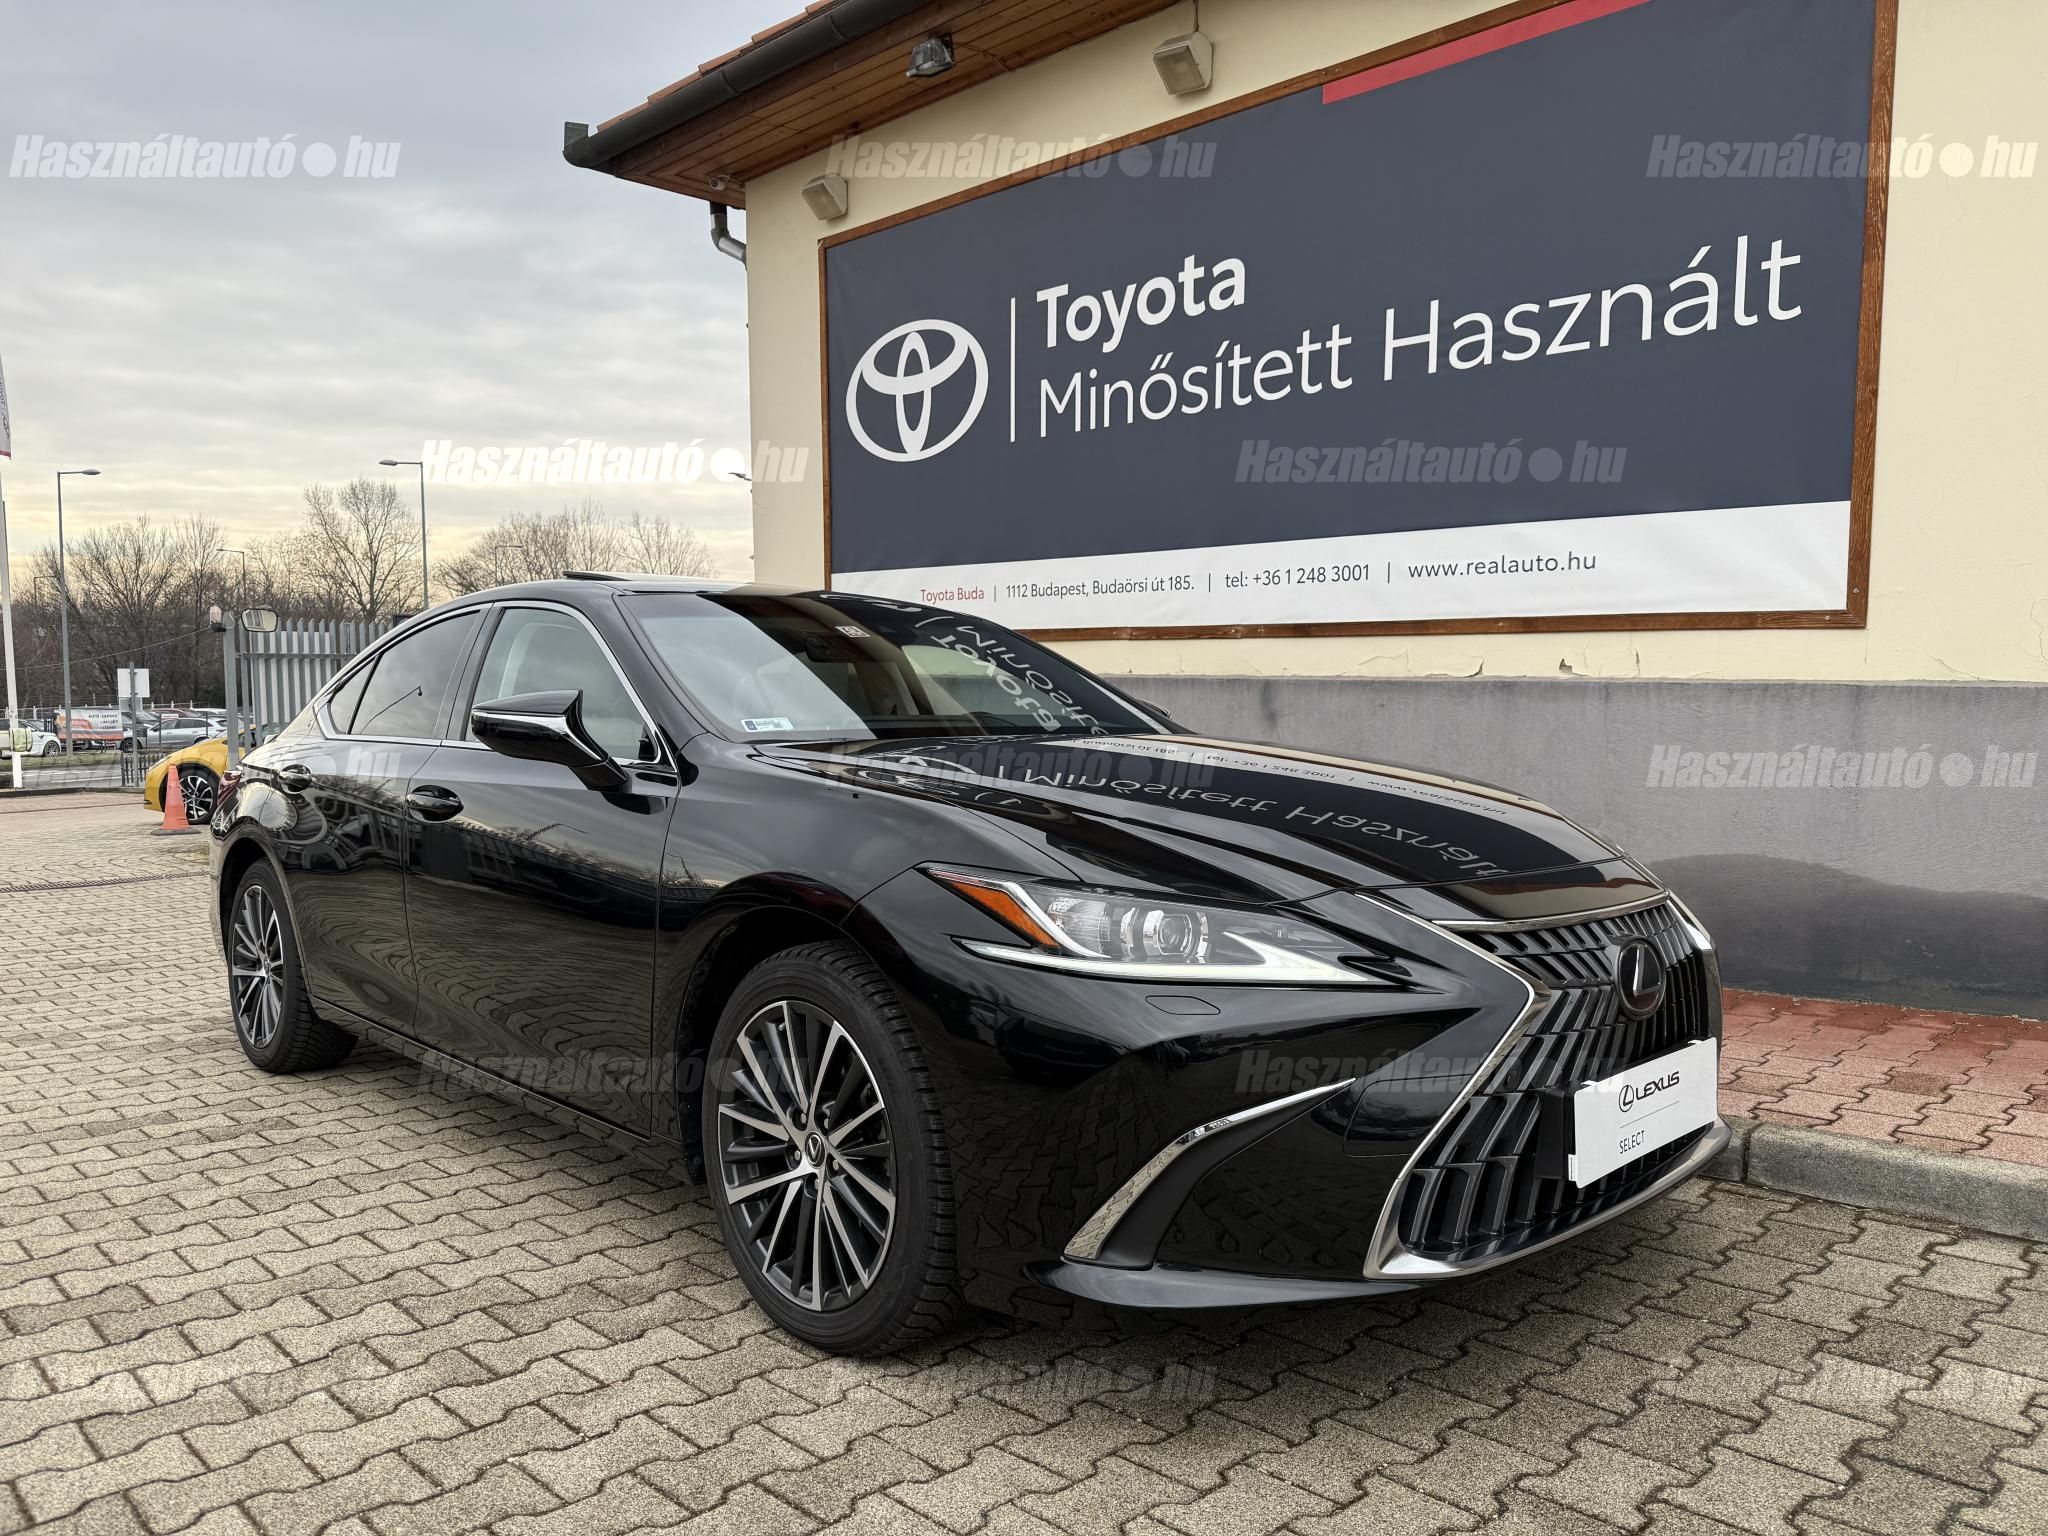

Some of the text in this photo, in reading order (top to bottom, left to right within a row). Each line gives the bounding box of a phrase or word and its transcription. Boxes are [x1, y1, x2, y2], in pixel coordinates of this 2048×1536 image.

[1036, 255, 1245, 353] Toyota
[1041, 235, 1802, 438] Minősített Használt
[1225, 564, 1370, 588] tel: +36 1 248 3001
[1408, 551, 1597, 579] www.realauto.hu
[920, 586, 985, 605] Toyota Buda
[1006, 575, 1195, 601] 1112 Budapest, Budaörsi út 185.
[1635, 1070, 1680, 1101] LEXUS
[1619, 1130, 1646, 1154] SELECT
